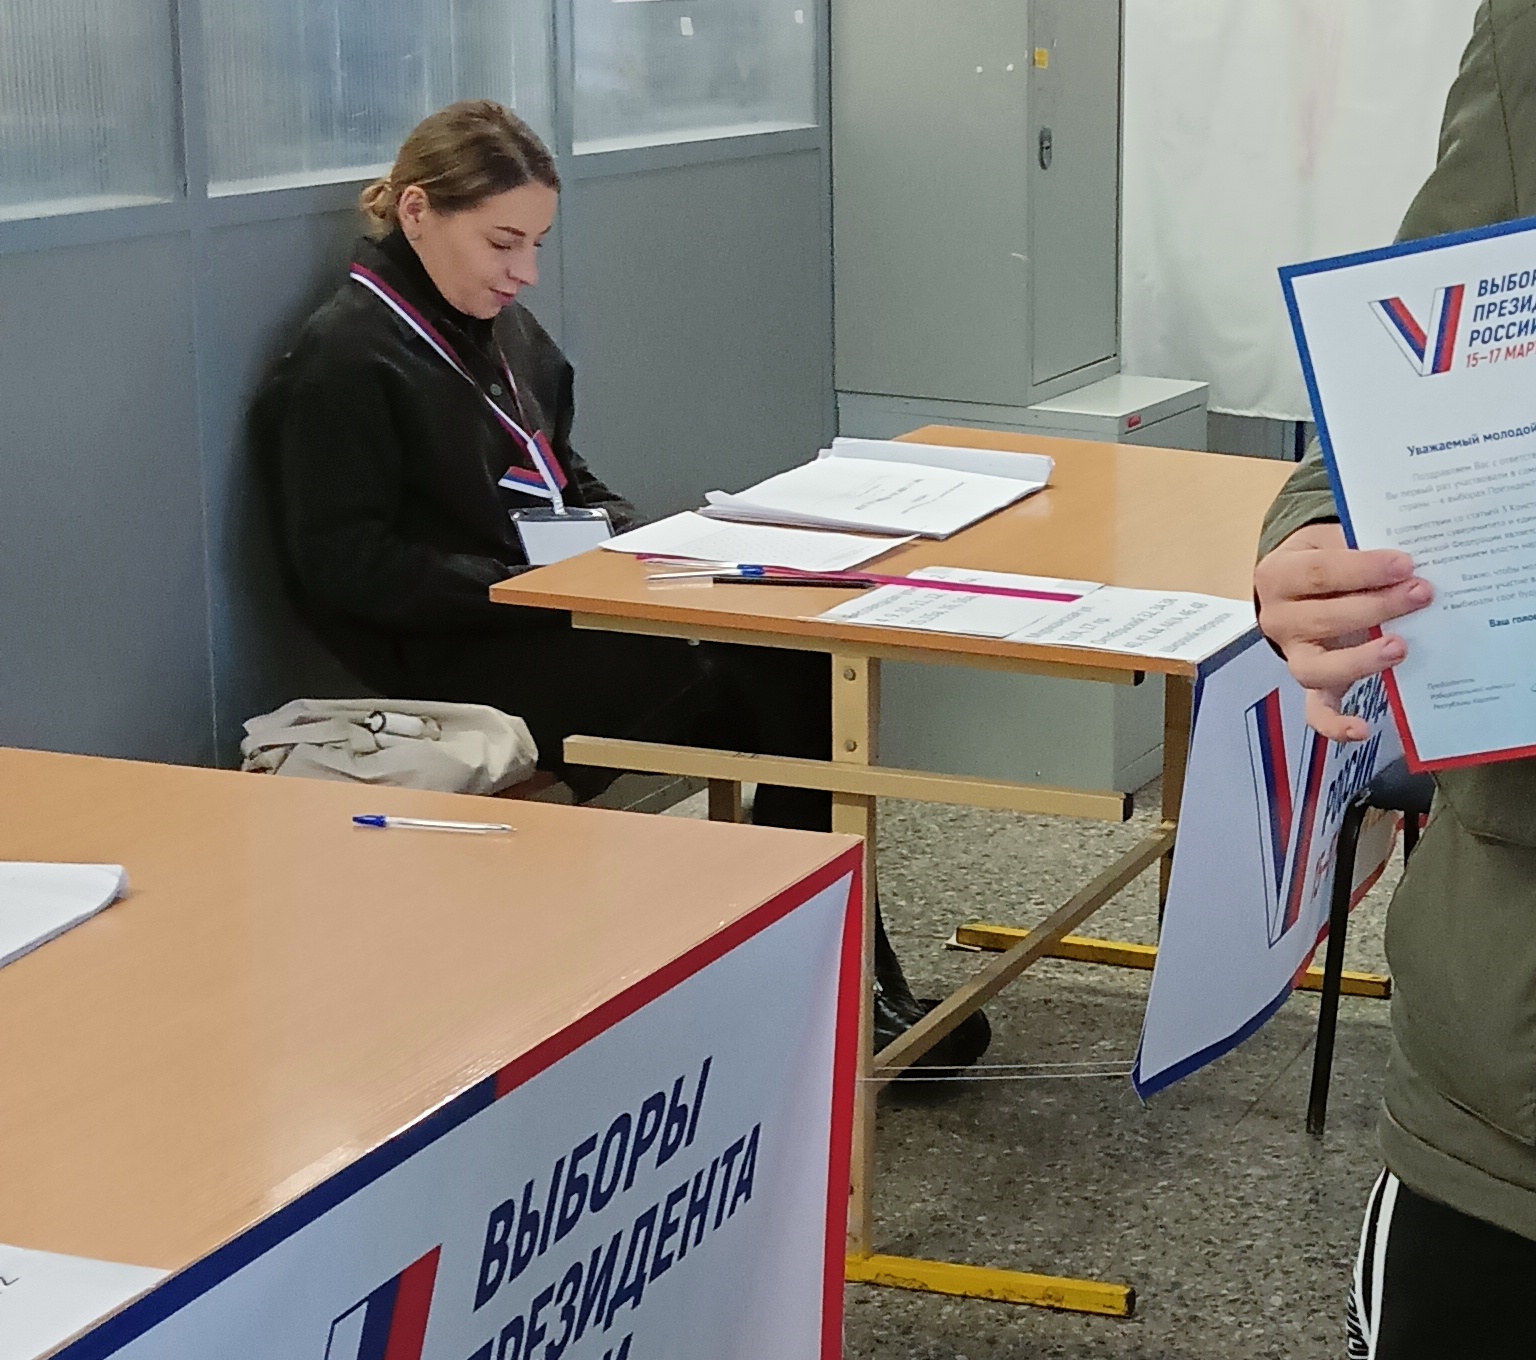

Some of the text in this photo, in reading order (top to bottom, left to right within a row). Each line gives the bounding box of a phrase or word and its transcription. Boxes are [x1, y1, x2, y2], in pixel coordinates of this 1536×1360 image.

[1406, 432, 1480, 456] Уважаемый
[1488, 615, 1510, 628] Ваш
[472, 1055, 713, 1313] ВЫБОРЫ
